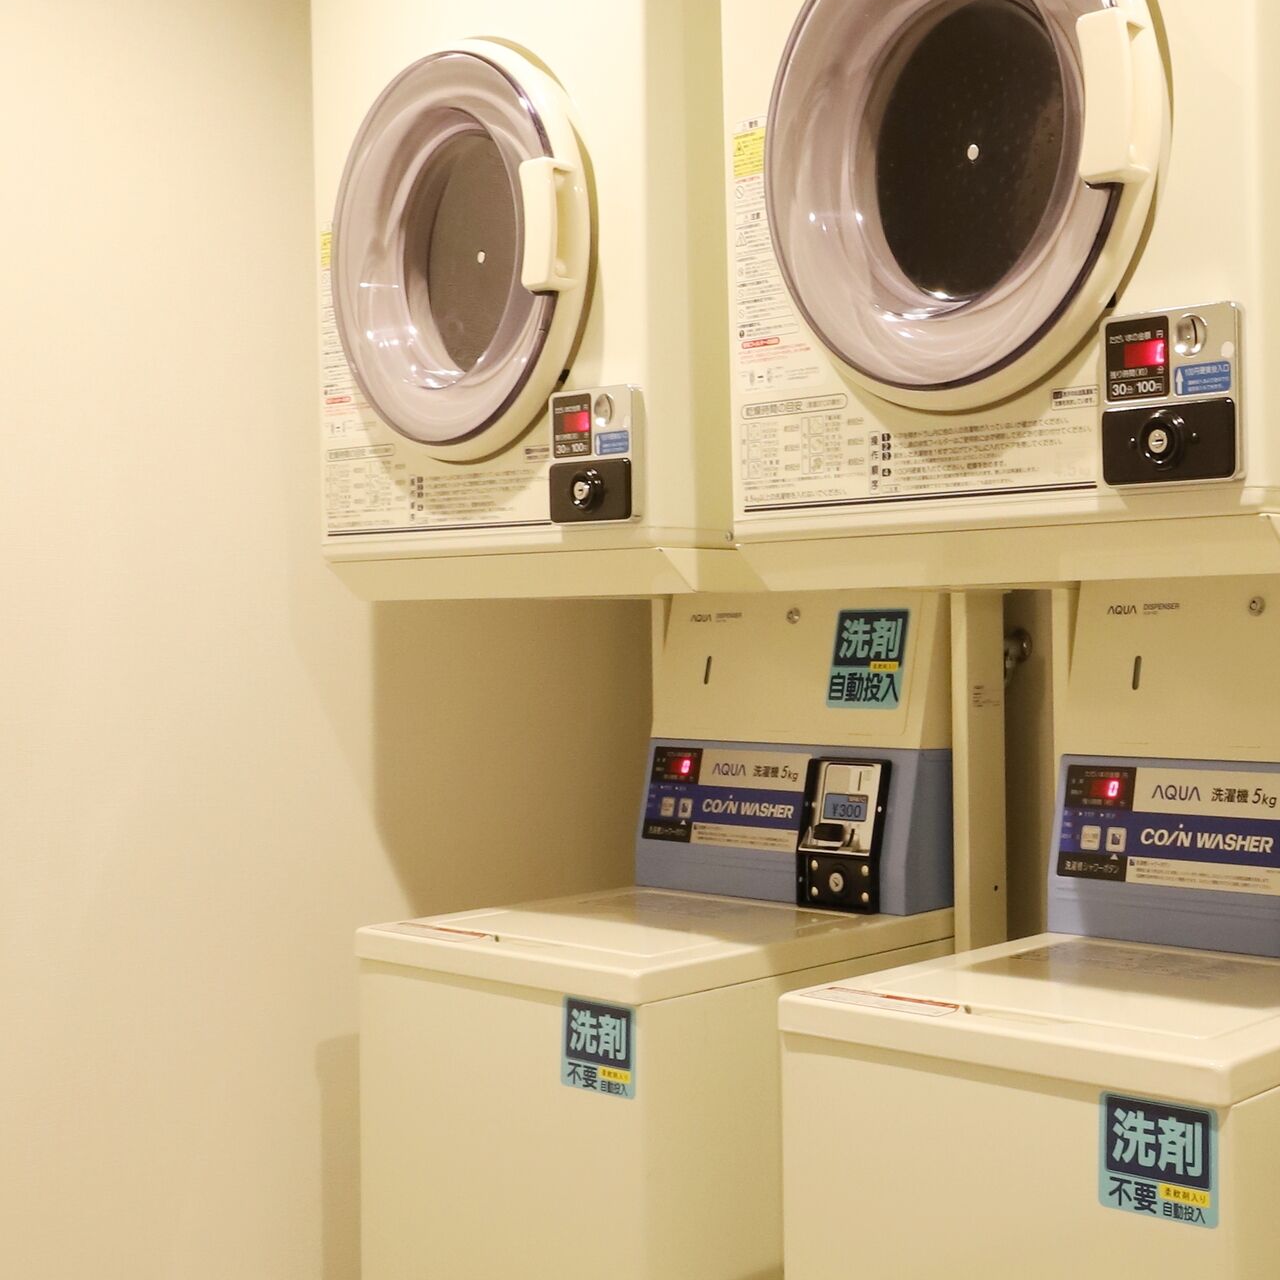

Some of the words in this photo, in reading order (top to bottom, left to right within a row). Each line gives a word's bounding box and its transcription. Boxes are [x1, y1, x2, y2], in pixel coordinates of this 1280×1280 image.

[1107, 604, 1138, 616] AQUA
[839, 618, 903, 660] 洗剤
[828, 672, 900, 703] 自動投入
[712, 762, 747, 777] AQUA
[752, 765, 780, 778] 洗濯機
[780, 765, 800, 782] 5kg
[1107, 780, 1120, 797] 0
[1152, 784, 1203, 802] AQUA
[1211, 787, 1249, 804] 洗濯機
[1251, 788, 1277, 809] 5kg
[740, 801, 795, 819] WASHER
[832, 803, 862, 818] ¥300
[1196, 832, 1274, 854] WASHER
[569, 1007, 627, 1060] 洗剤
[567, 1061, 598, 1090] 不要
[1111, 1107, 1203, 1177] 洗剤
[1108, 1175, 1158, 1215] 不要
[1162, 1202, 1206, 1224] 自動投入
